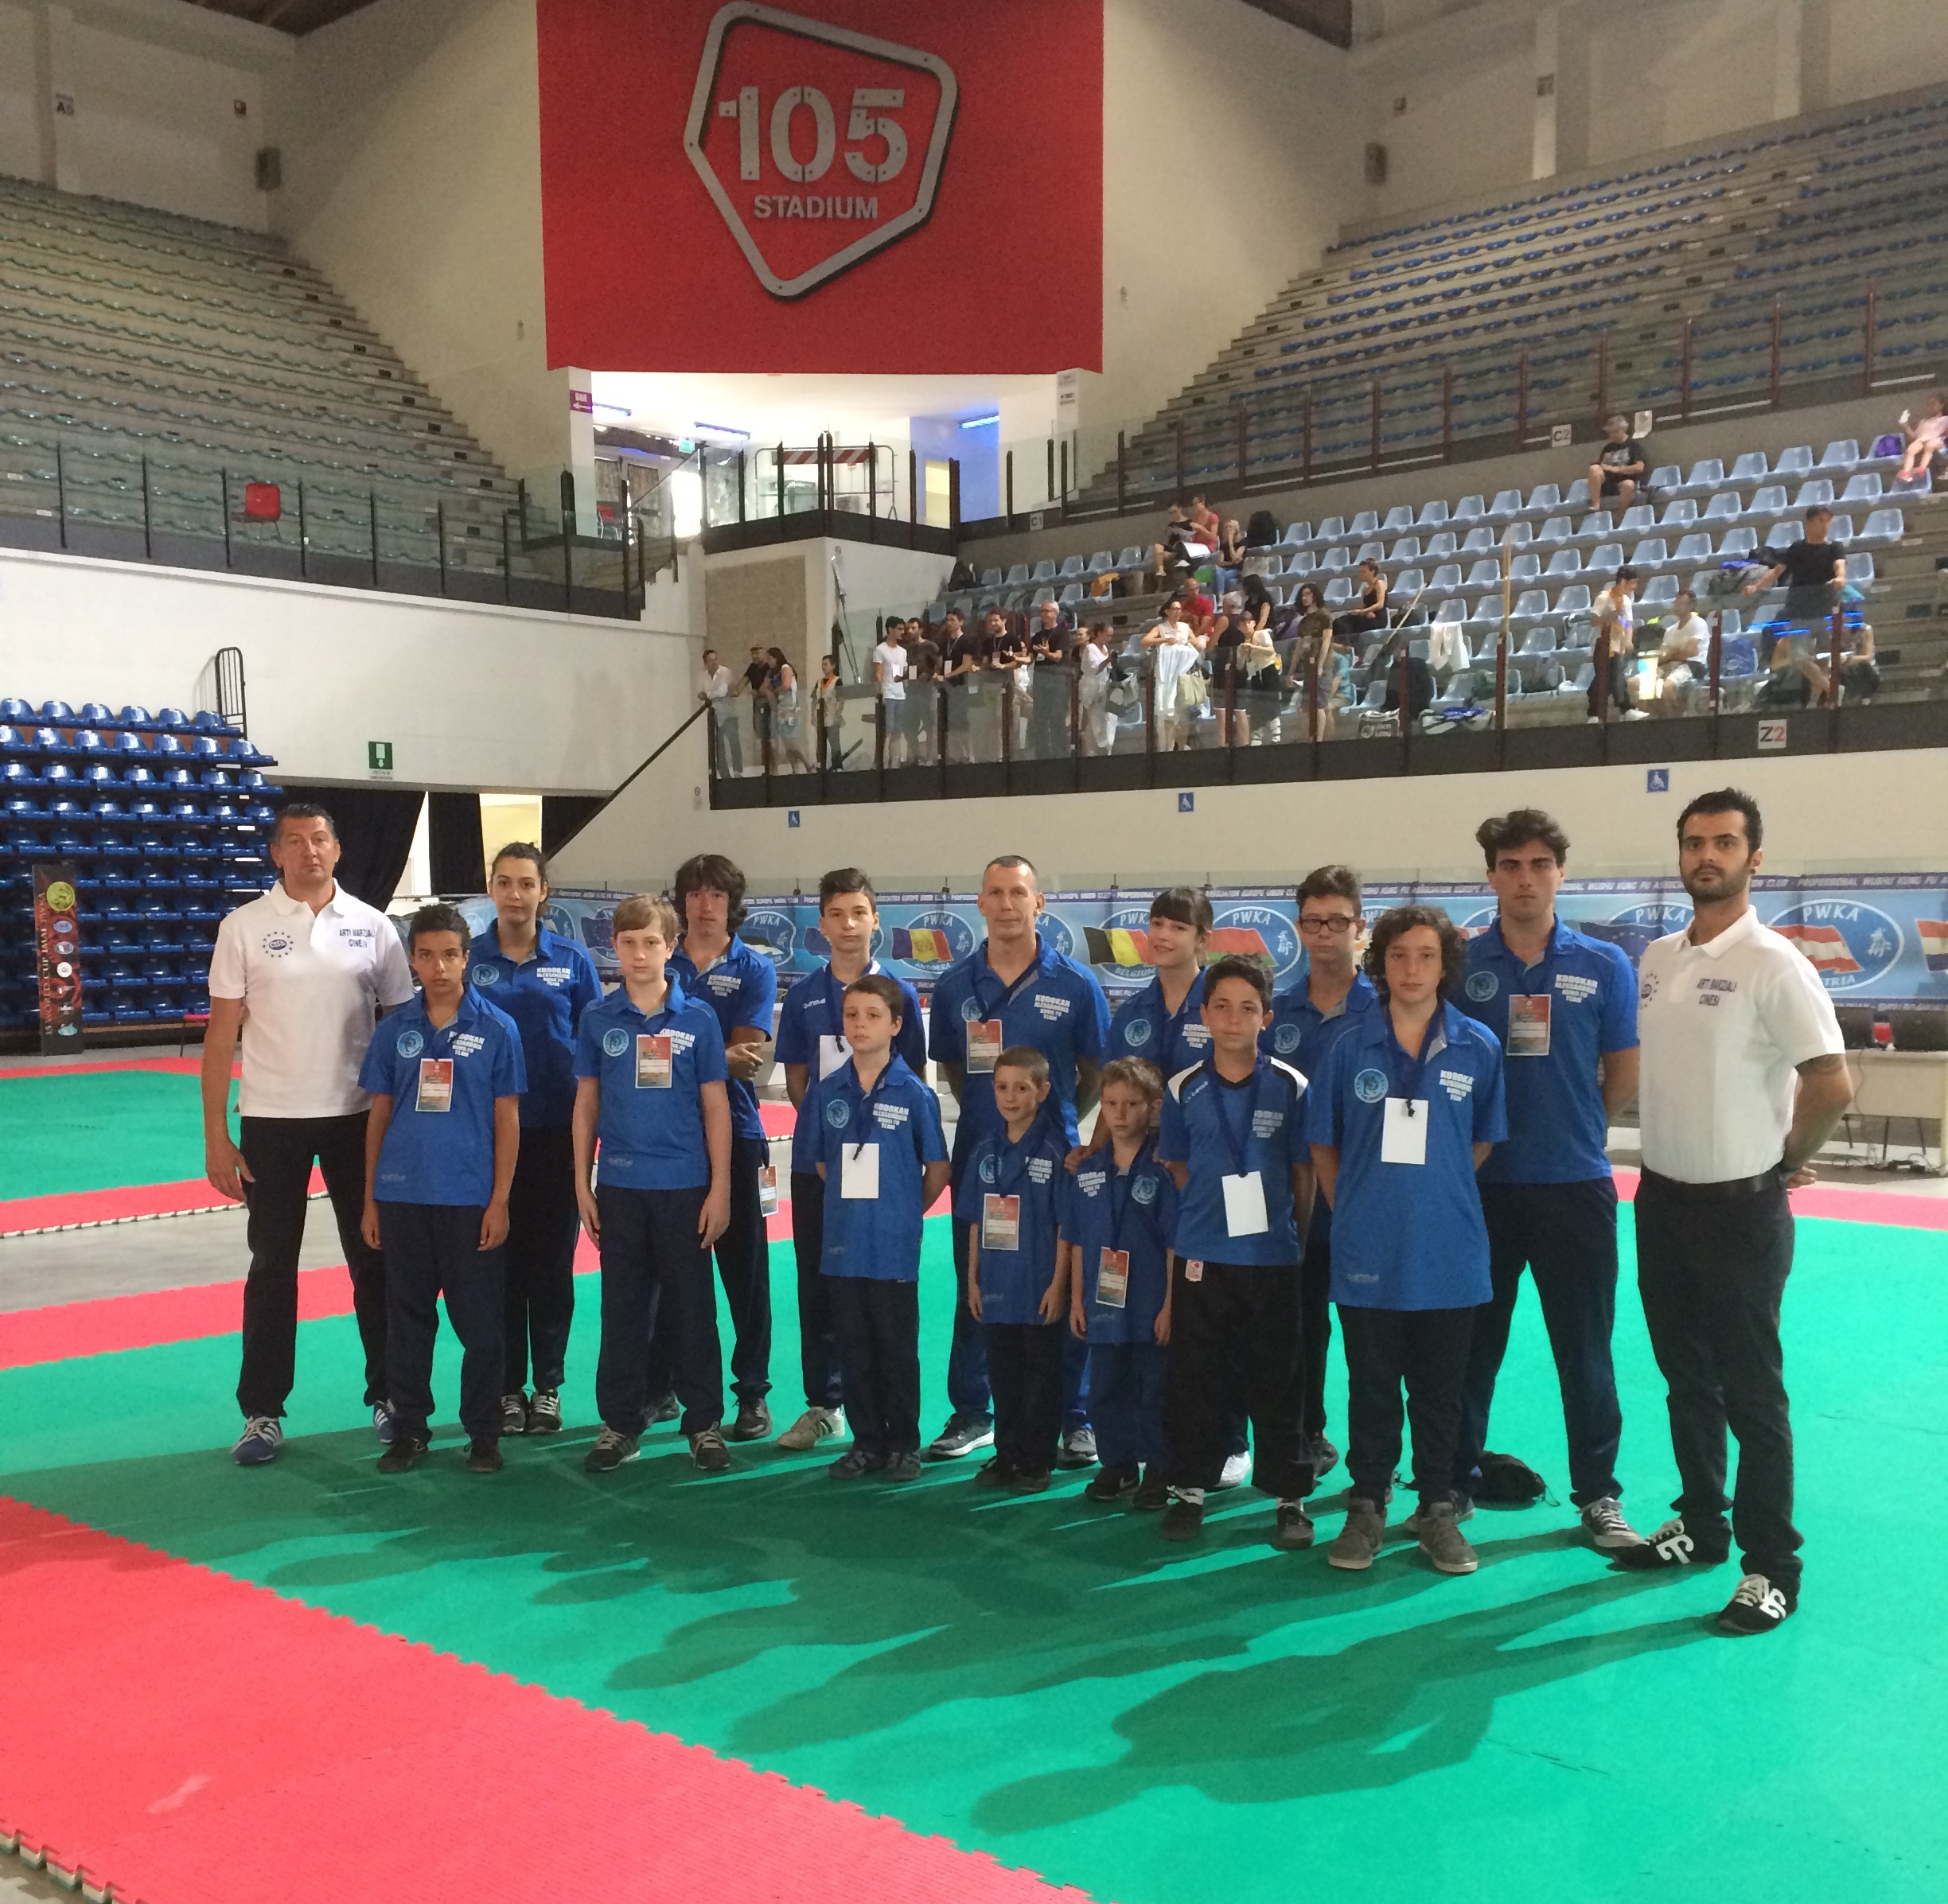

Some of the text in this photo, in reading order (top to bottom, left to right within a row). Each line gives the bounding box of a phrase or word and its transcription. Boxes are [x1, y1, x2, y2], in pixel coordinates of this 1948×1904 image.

[719, 86, 908, 182] 105
[754, 195, 878, 219] STADIUM
[1554, 429, 1570, 442] C2
[1760, 726, 1786, 742] Z2
[753, 914, 780, 926] PWKA
[1120, 912, 1150, 926] PWK
[1232, 910, 1271, 925] PWKA
[1635, 905, 1686, 923] PWKA
[1802, 904, 1859, 922] PWKA
[923, 914, 953, 927] PWKA
[1035, 915, 1050, 927] KA
[914, 962, 953, 971] ANDORRA
[1114, 967, 1157, 978] BELGIUM
[1823, 974, 1856, 987] TRIA
[43, 983, 53, 1022] WORLD
